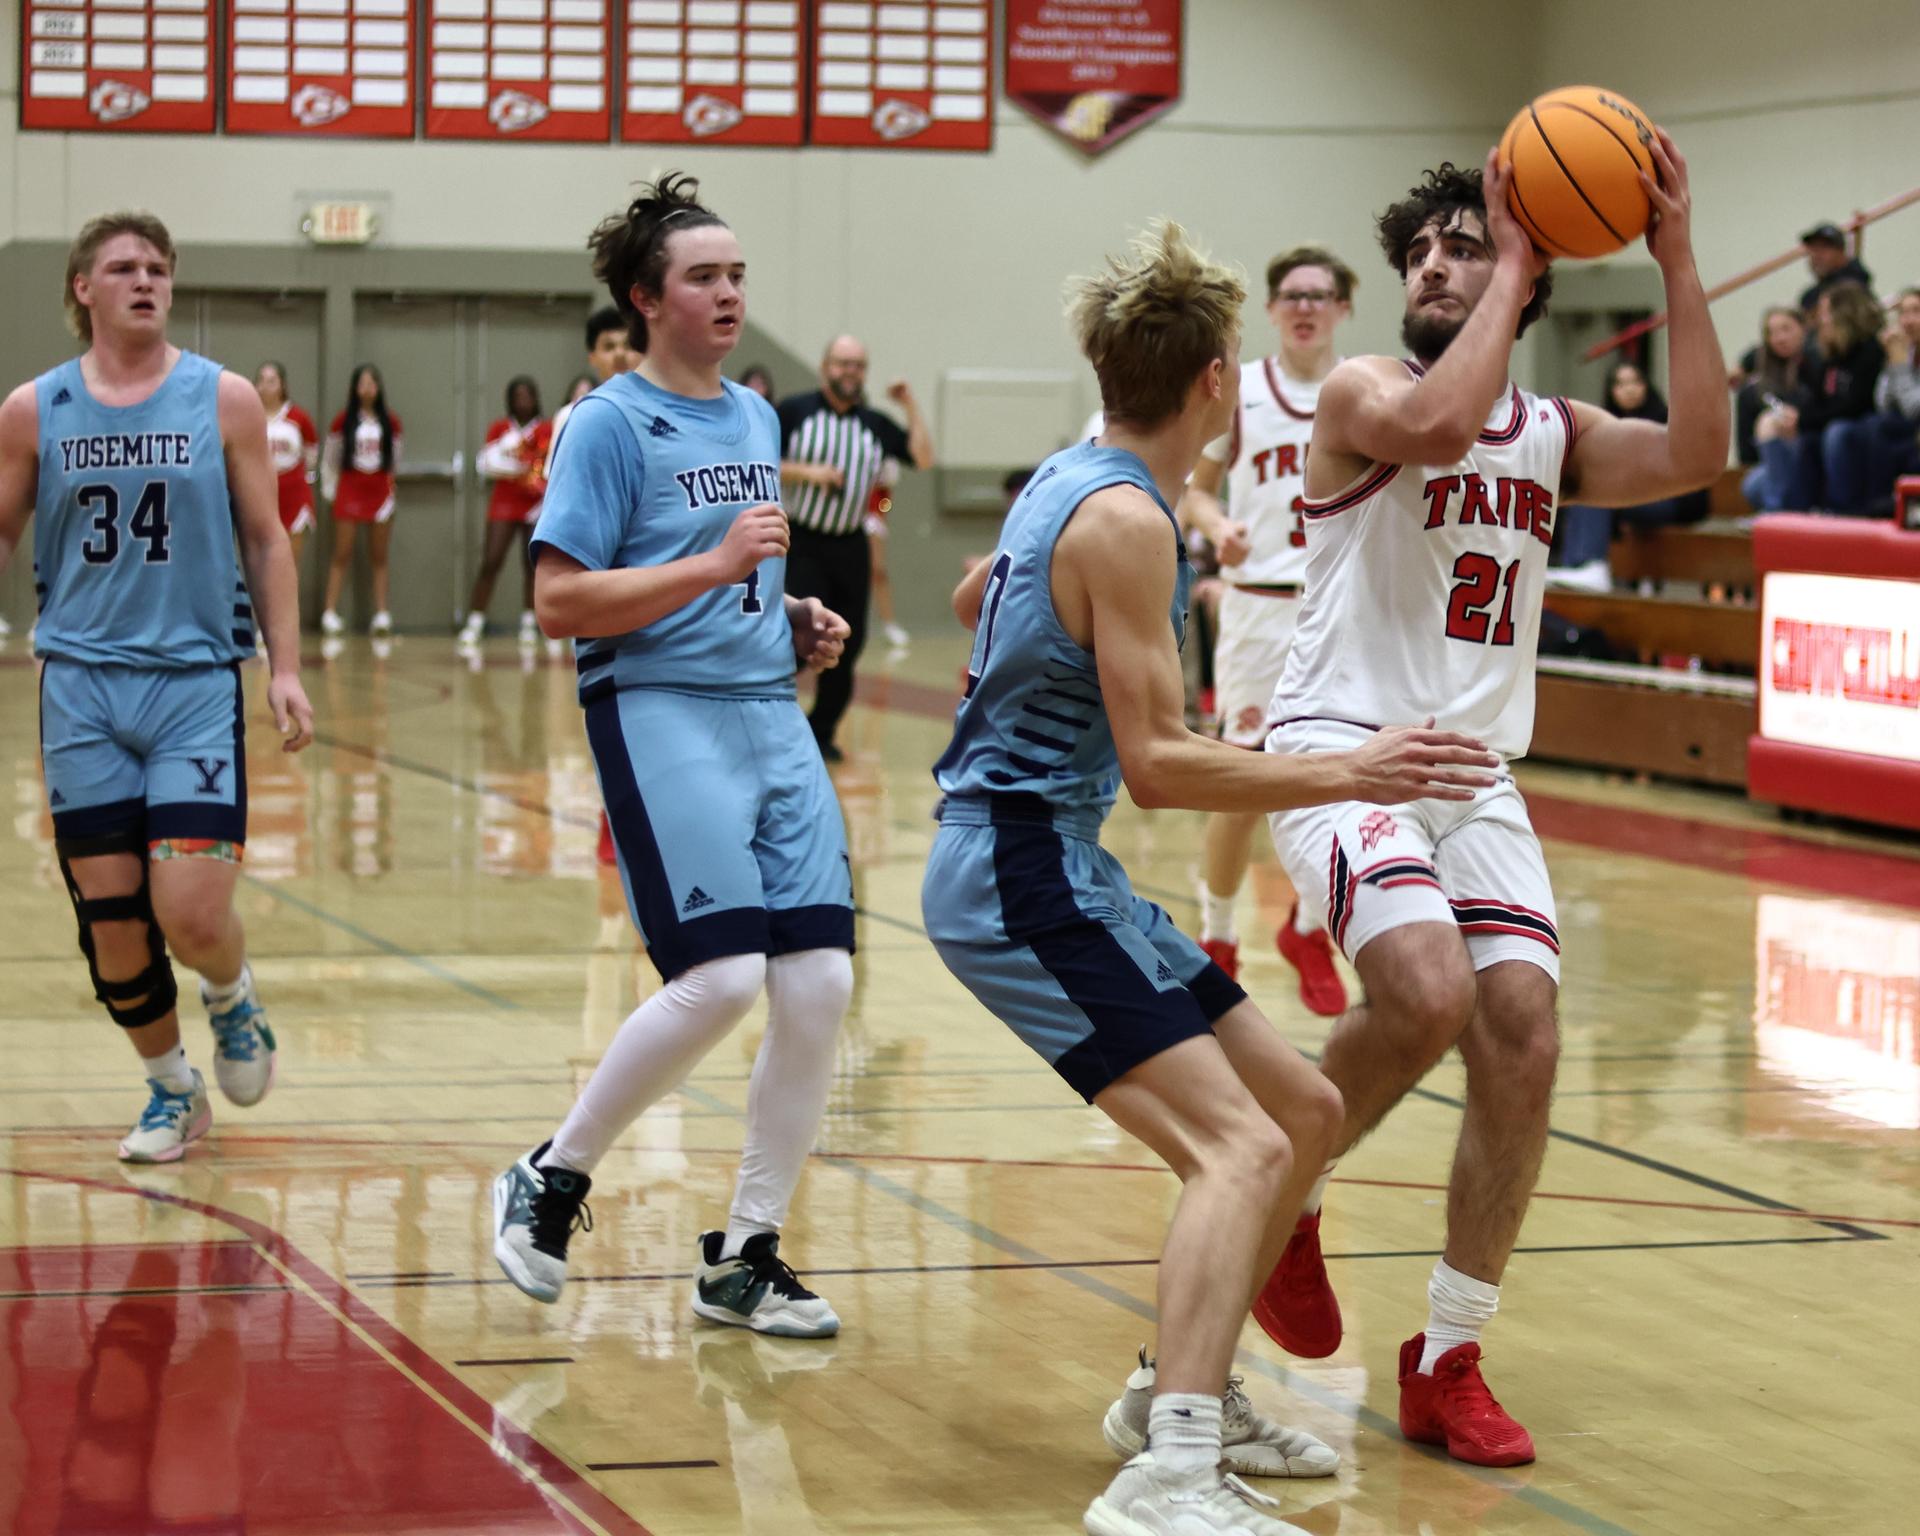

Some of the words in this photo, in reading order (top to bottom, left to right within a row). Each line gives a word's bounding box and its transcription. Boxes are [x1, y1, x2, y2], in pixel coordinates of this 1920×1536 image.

[60, 433, 191, 473] YOSEMITE
[77, 481, 171, 564] 34
[1445, 551, 1520, 646] 21
[188, 756, 230, 795] Y
